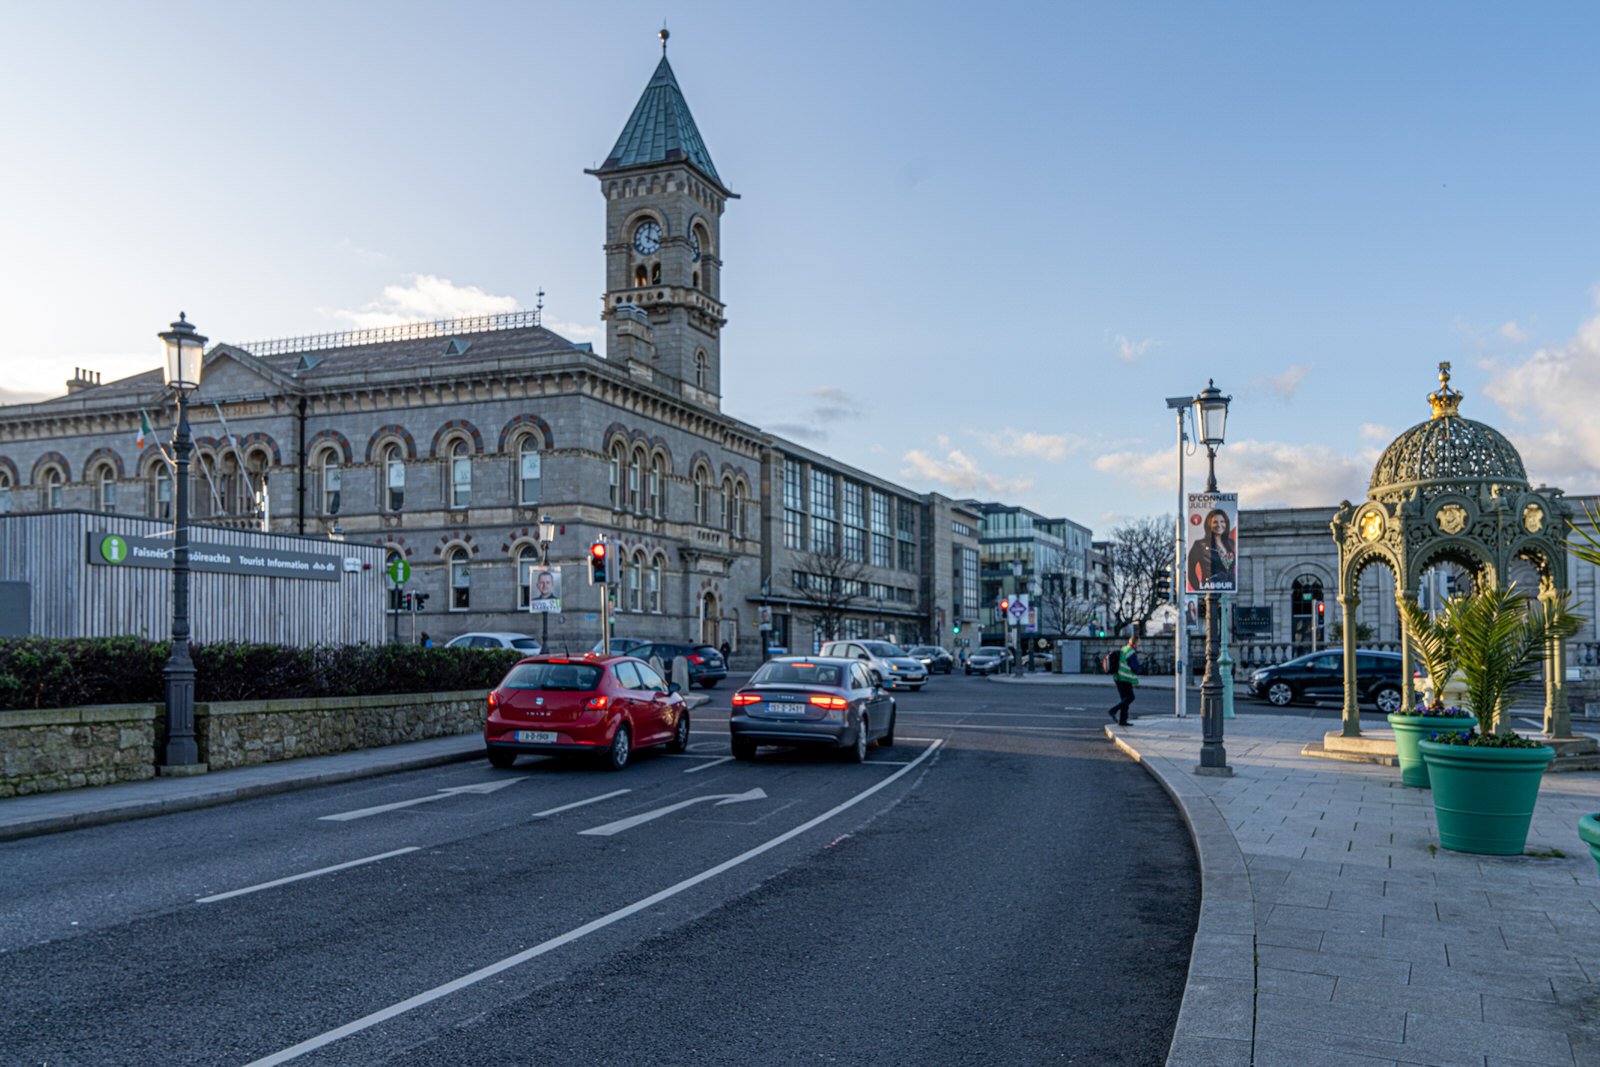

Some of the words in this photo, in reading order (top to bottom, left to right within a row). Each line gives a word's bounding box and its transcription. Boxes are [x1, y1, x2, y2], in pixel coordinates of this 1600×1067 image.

[233, 404, 264, 416] HALL
[133, 546, 168, 559] Faisnéis
[238, 555, 265, 567] Tourist
[267, 558, 309, 571] Information
[1199, 581, 1233, 590] LABOUR
